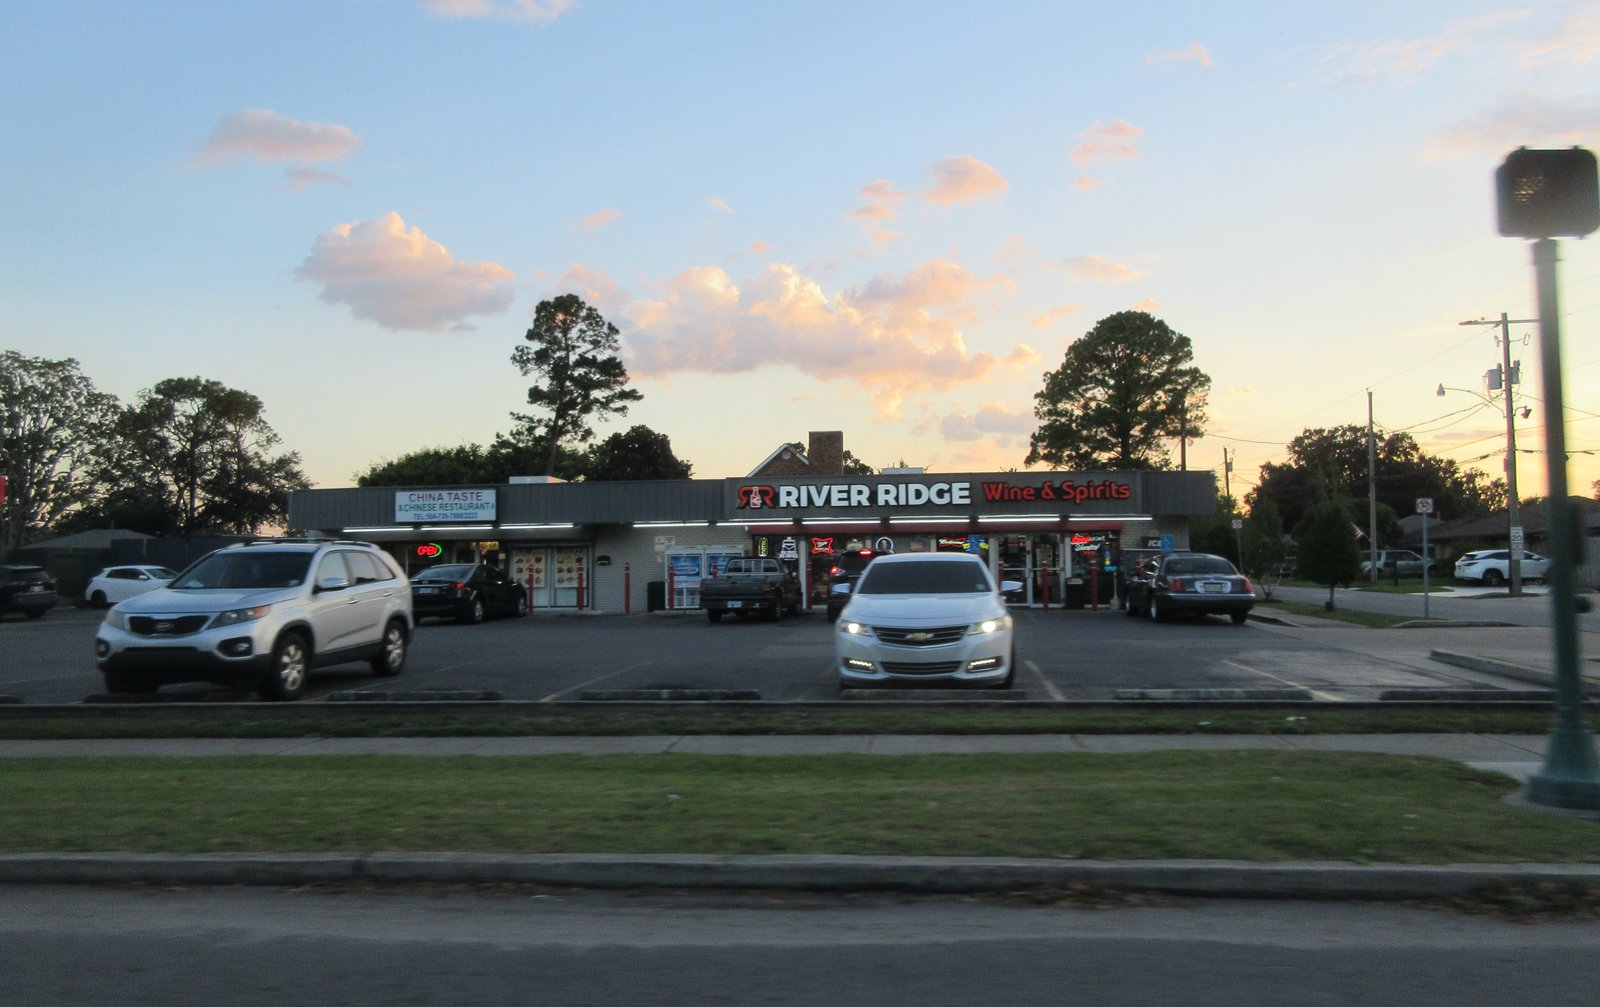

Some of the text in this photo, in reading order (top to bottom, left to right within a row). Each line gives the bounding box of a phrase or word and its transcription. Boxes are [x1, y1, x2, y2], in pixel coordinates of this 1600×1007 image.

[409, 491, 483, 503] CHINA TASTE
[779, 482, 971, 507] RIVER RIDGE
[983, 480, 1131, 504] Wine & Spirits
[439, 502, 490, 511] RESTAURANT
[417, 545, 438, 556] OPEN
